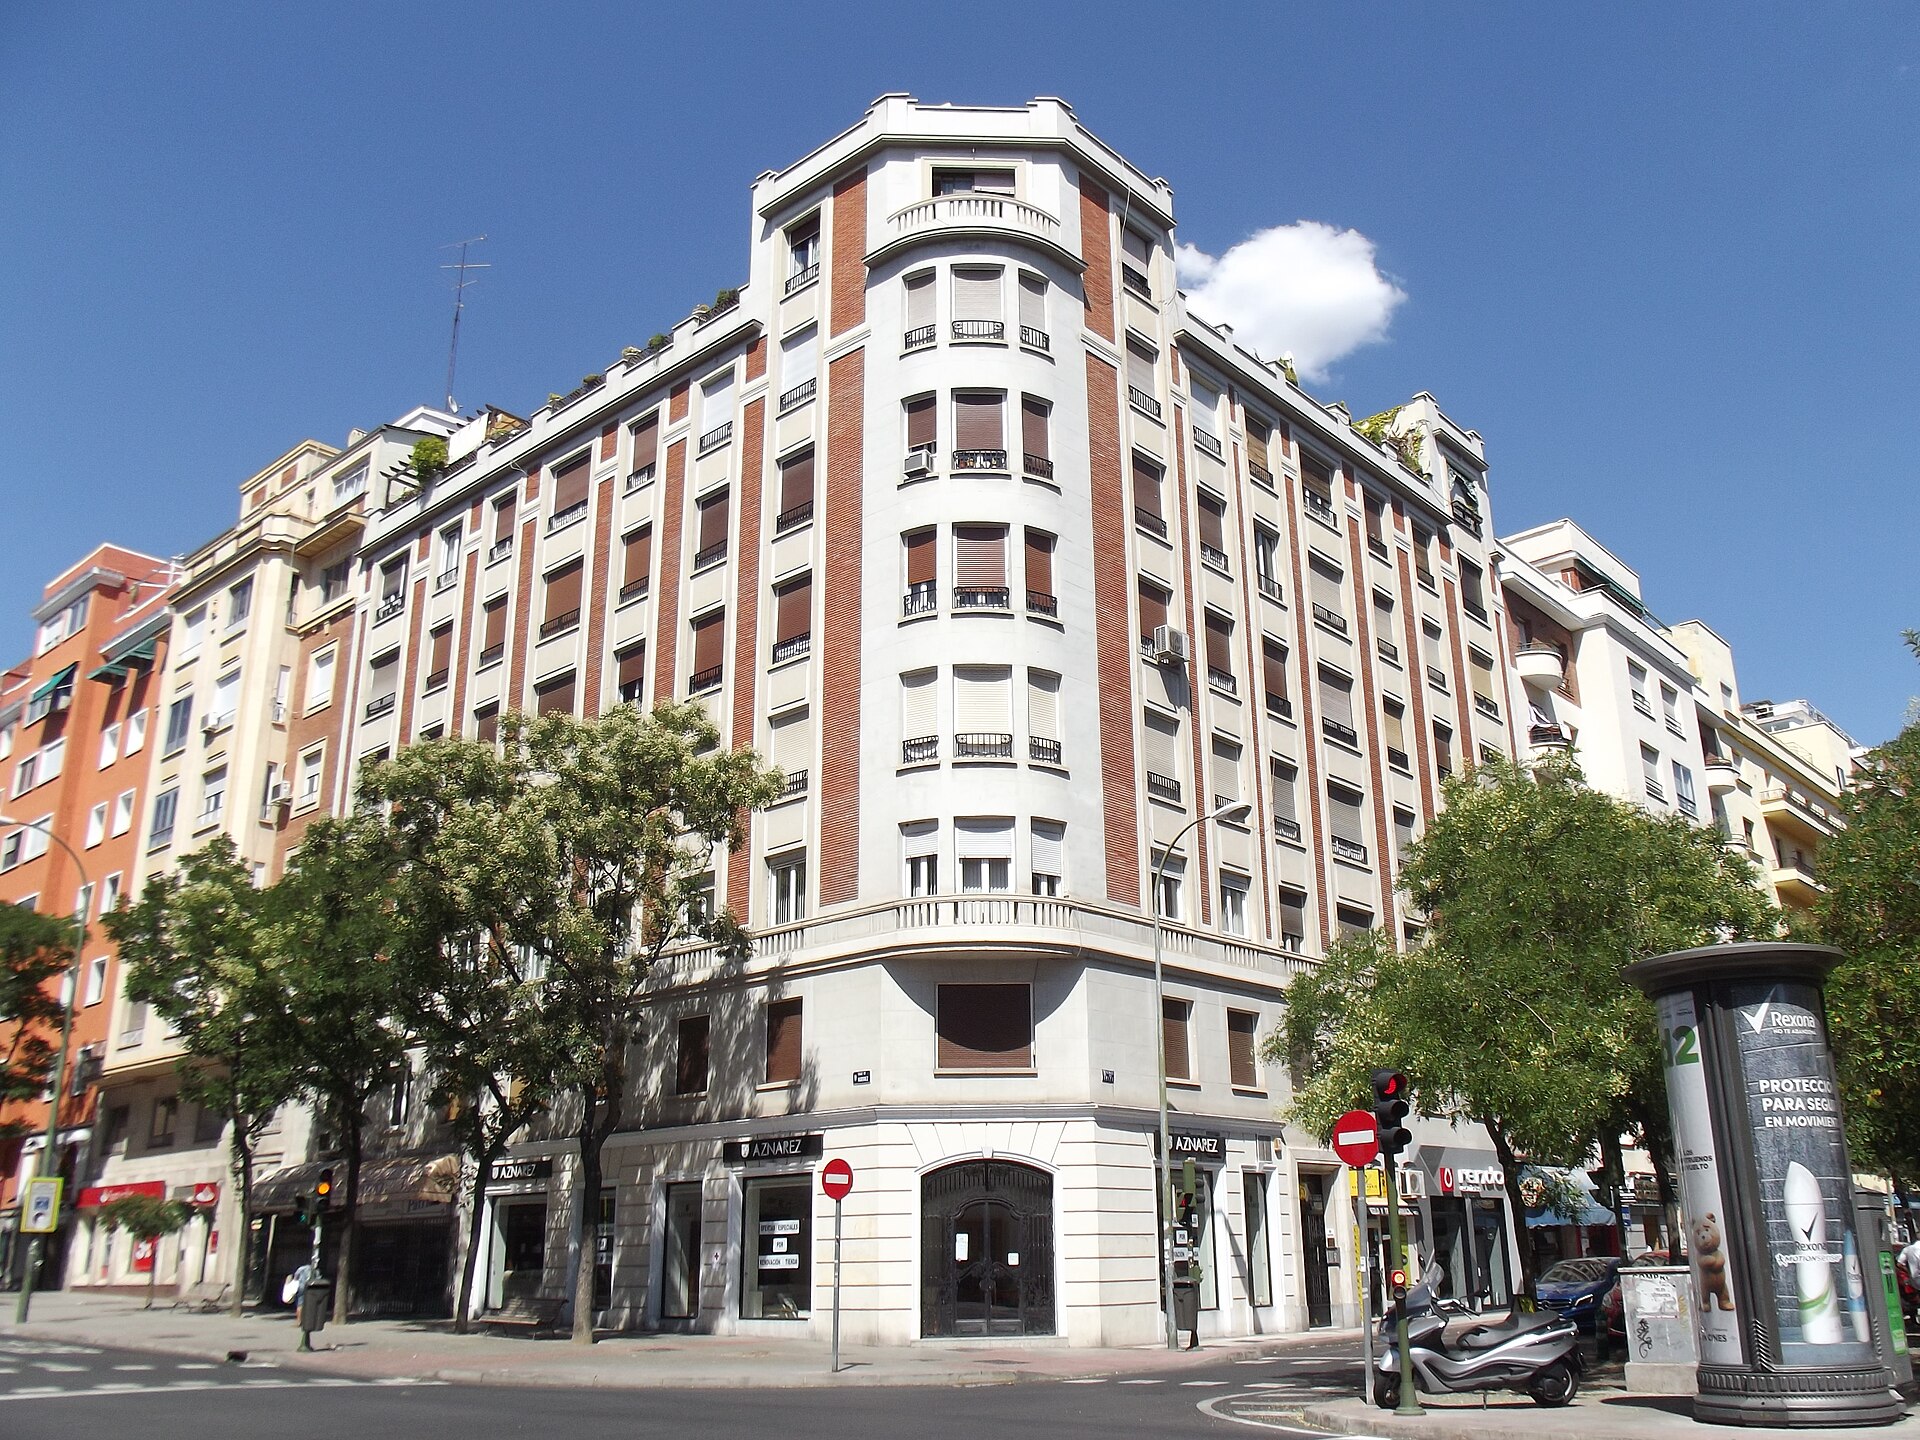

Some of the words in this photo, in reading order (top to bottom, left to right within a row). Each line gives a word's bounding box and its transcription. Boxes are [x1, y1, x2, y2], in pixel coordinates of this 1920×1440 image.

[1770, 1011, 1816, 1028] Rexona
[1761, 1097, 1806, 1112] PARA
[1764, 1116, 1783, 1128] EN
[752, 1139, 802, 1157] AZNAREZ
[1175, 1136, 1219, 1153] AZNAREZ
[500, 1163, 537, 1180] AZNAREZ
